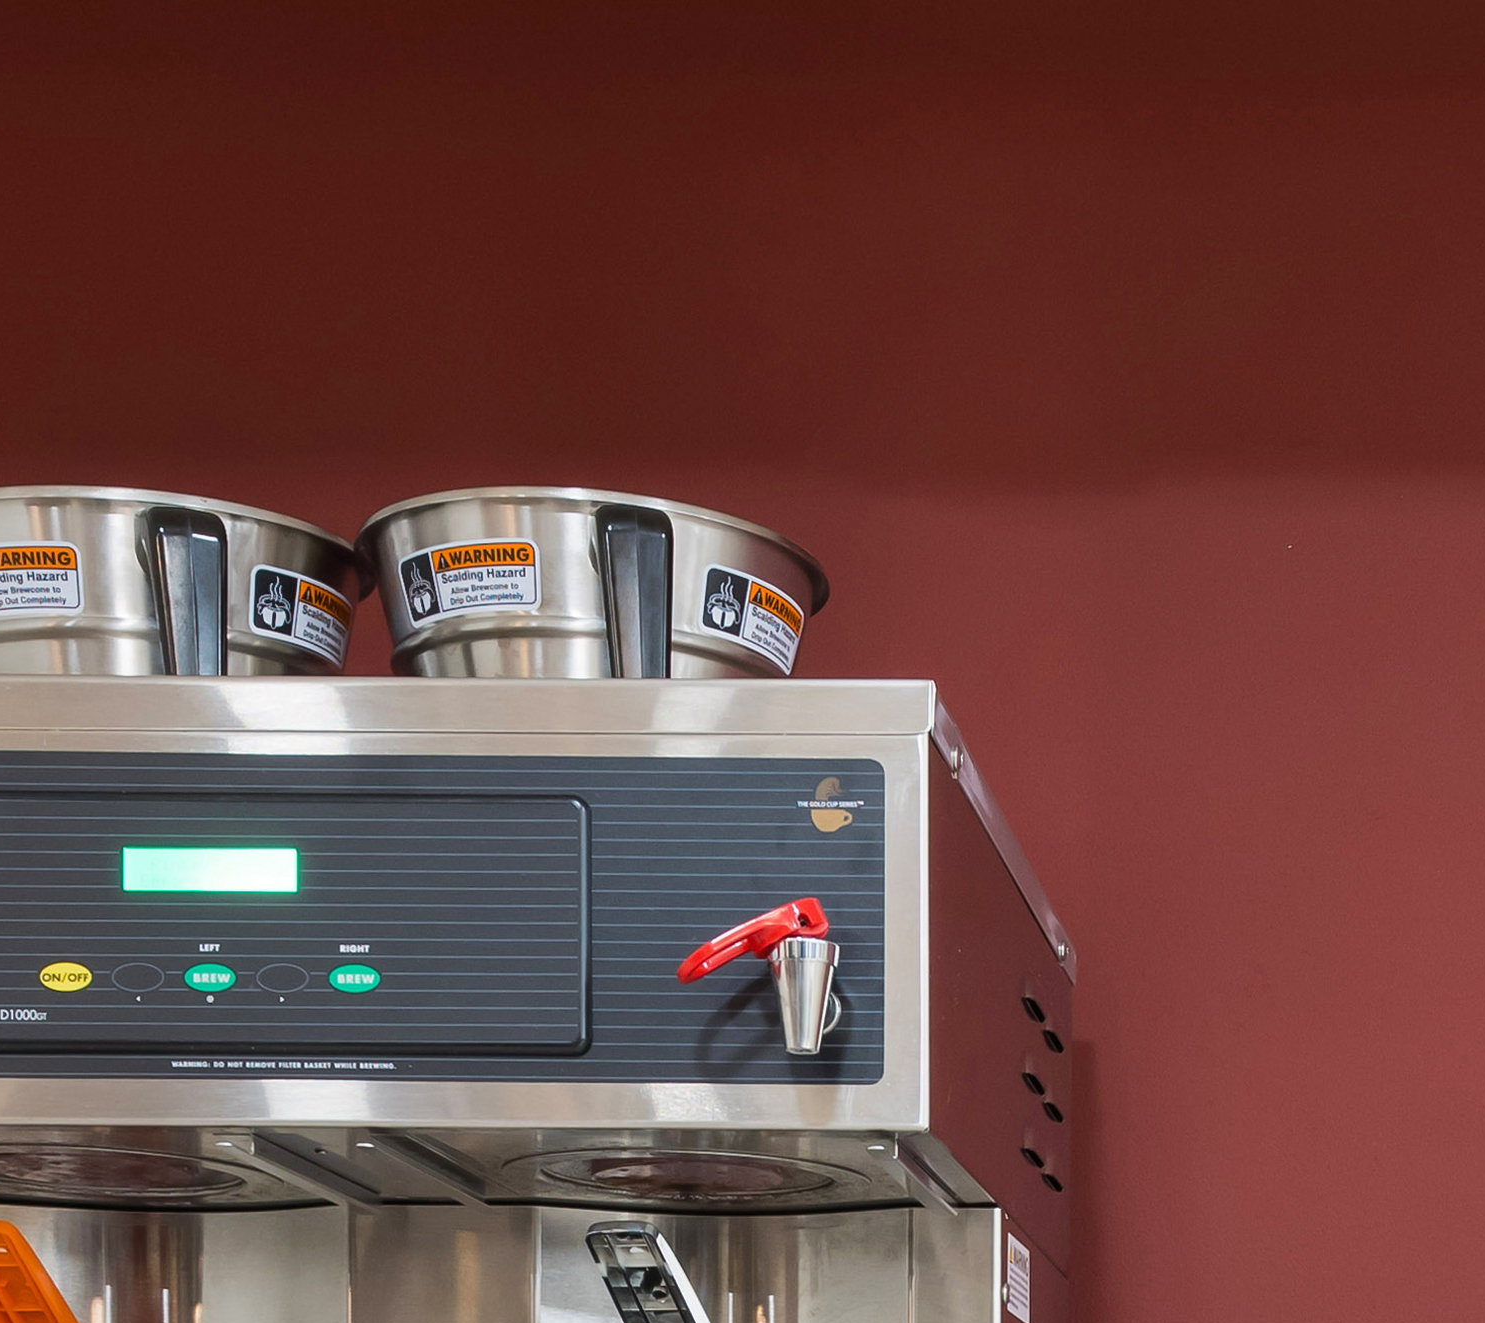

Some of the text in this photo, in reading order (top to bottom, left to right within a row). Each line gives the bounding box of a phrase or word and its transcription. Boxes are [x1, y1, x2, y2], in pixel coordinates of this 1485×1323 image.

[449, 547, 530, 566] WARNING
[26, 571, 68, 582] Hazard
[441, 567, 526, 585] Scalding Hazard
[52, 586, 61, 594] to
[510, 582, 519, 590] to
[5, 597, 19, 605] Out
[20, 595, 67, 606] Completely
[465, 595, 479, 603] Out
[480, 592, 524, 601] Completely
[199, 943, 220, 952] LEFT
[339, 944, 370, 953] RIGHT
[42, 973, 89, 983] ON/OFF
[192, 973, 231, 984] BREW
[337, 974, 375, 984] BREW
[171, 1061, 211, 1069] WARNING:
[246, 1061, 276, 1069] REMOVE
